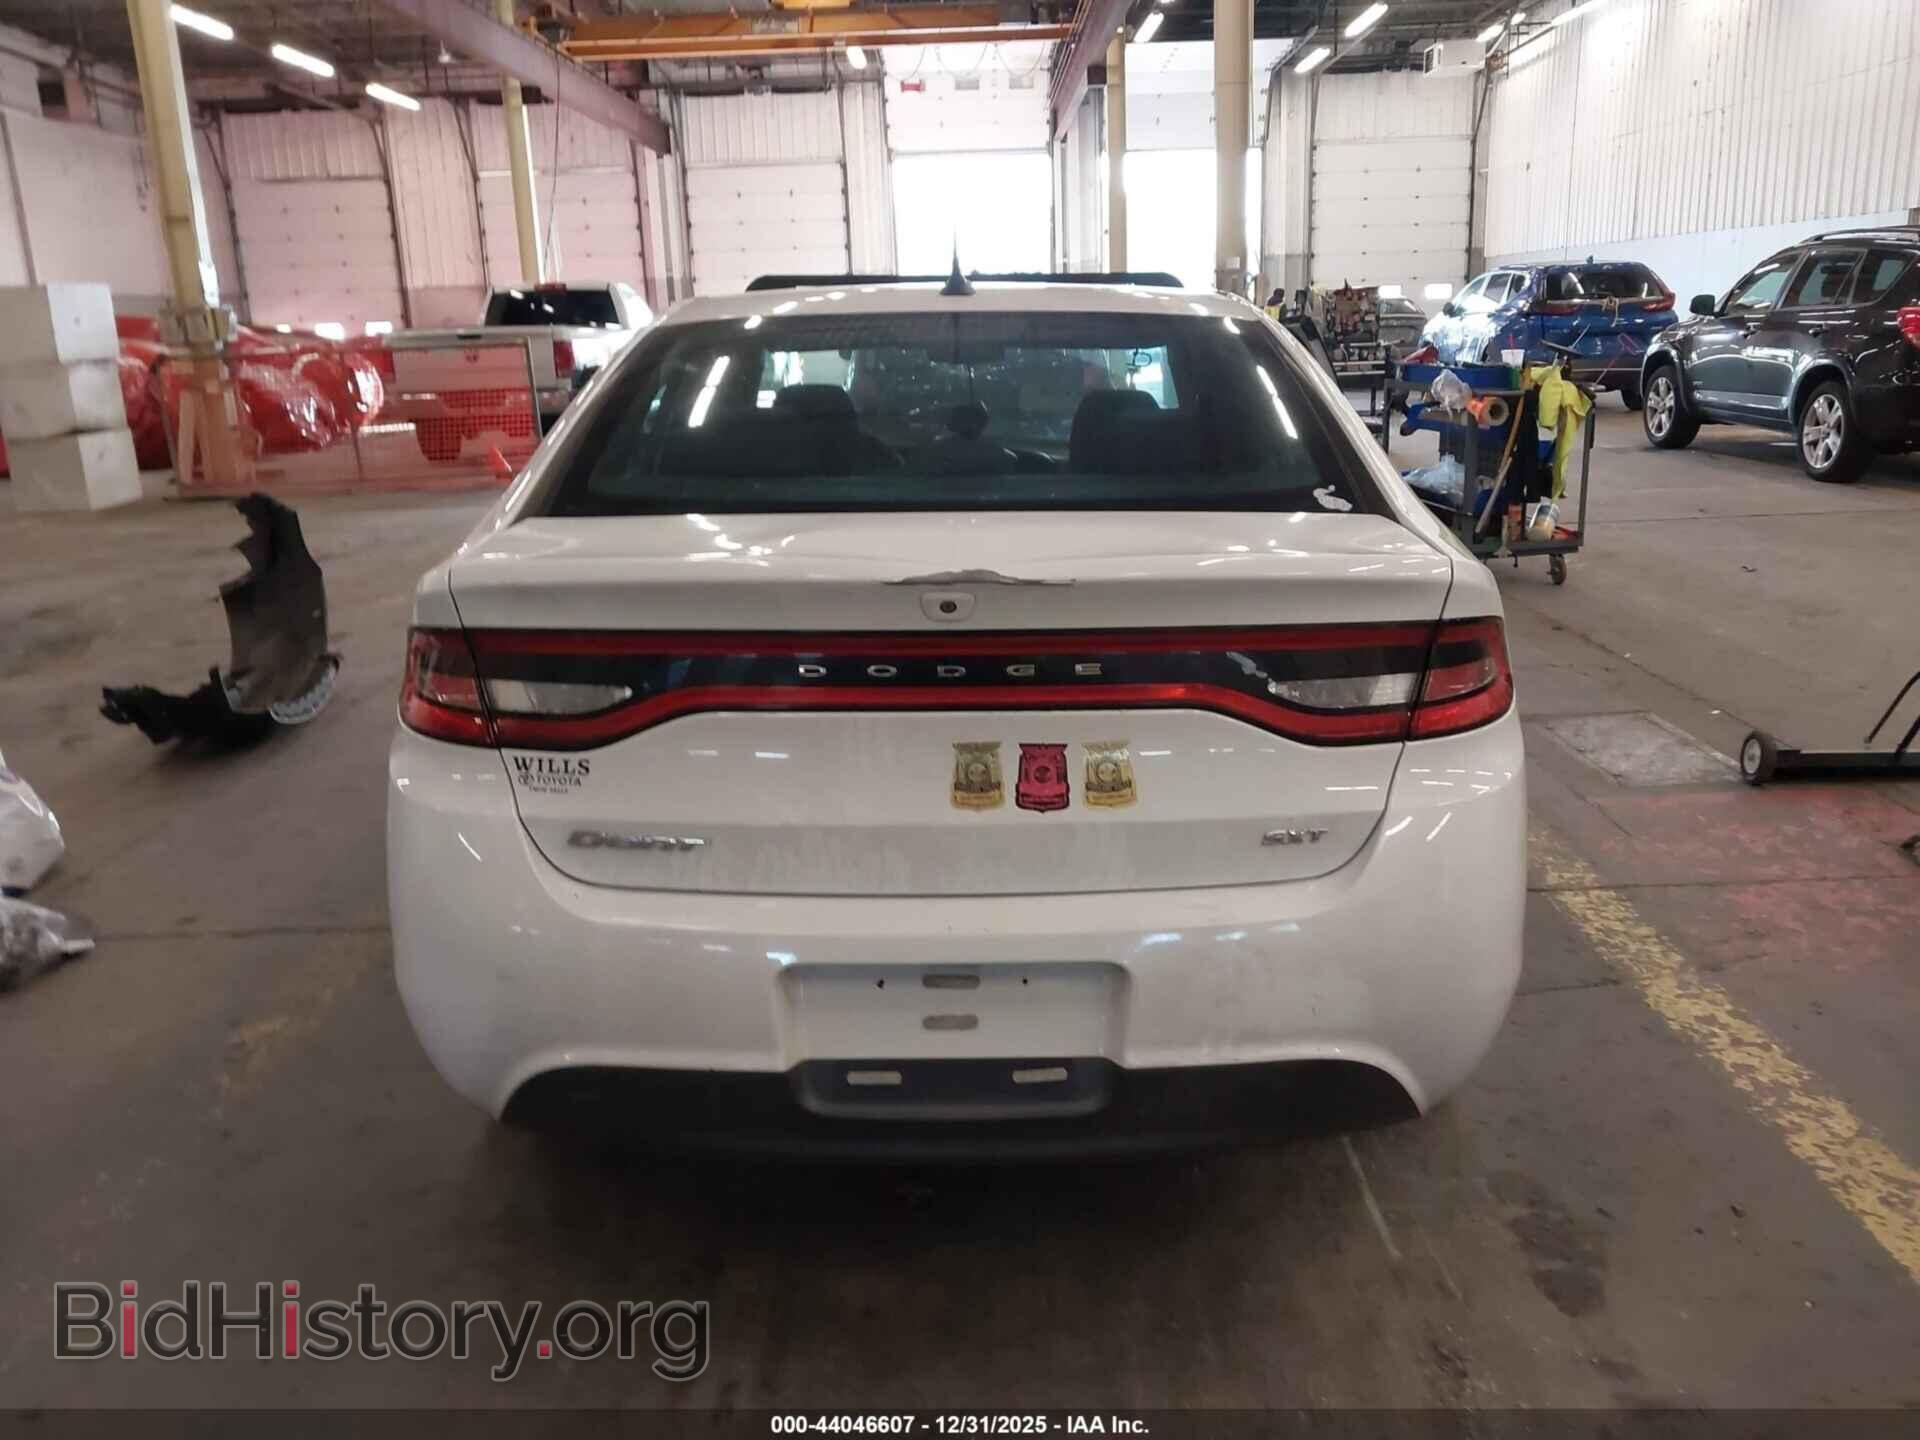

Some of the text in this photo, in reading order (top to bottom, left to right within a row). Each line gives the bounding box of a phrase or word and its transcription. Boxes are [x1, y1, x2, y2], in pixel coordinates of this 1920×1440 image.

[798, 662, 1103, 678] DODGE
[513, 756, 591, 776] WILLS
[530, 773, 582, 788] TOYOTA
